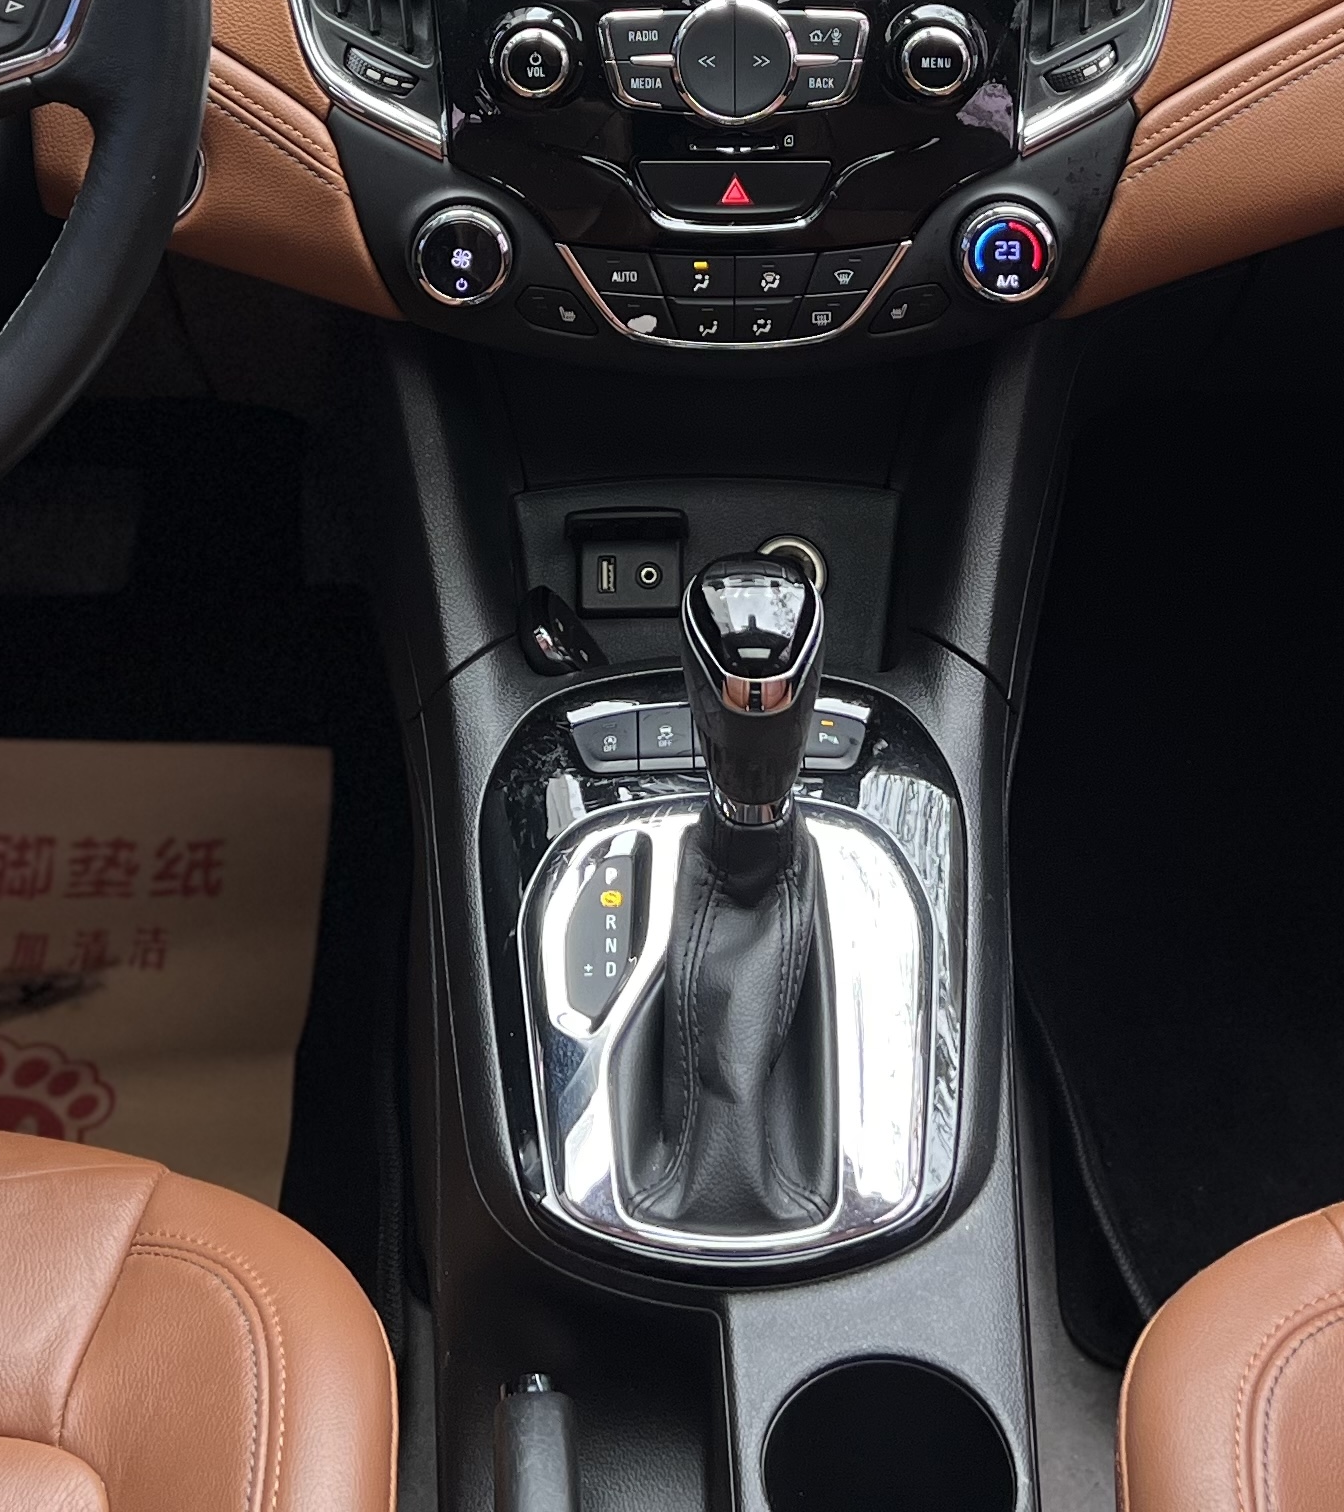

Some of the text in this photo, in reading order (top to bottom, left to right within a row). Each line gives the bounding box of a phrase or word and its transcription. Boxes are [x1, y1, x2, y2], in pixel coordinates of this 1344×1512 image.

[628, 30, 659, 42] RADIO
[921, 57, 951, 69] MENU
[527, 67, 546, 78] VOL
[630, 77, 662, 89] MEDIA
[808, 77, 835, 89] BACK
[994, 240, 1021, 260] 23
[611, 271, 638, 283] AUTO
[996, 274, 1019, 288] A/C
[605, 867, 618, 885] P
[605, 914, 617, 930] R
[605, 937, 617, 953] N
[605, 961, 617, 977] D
